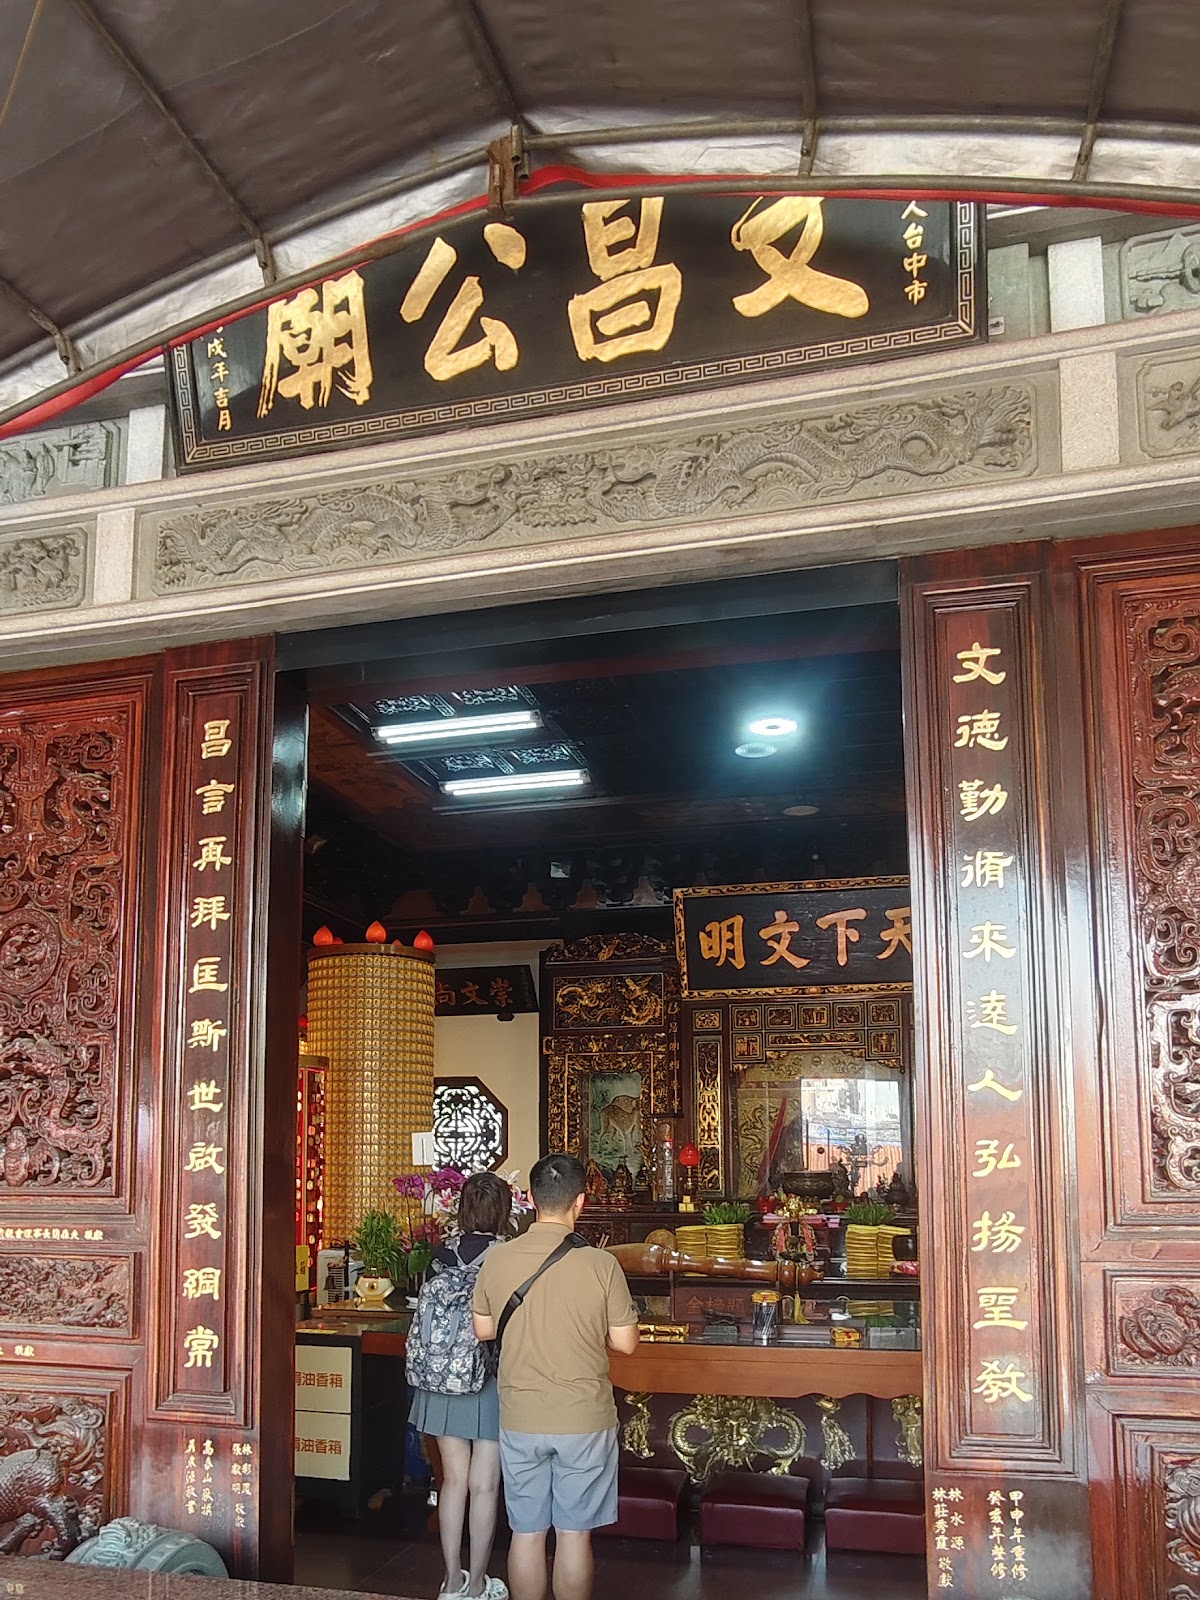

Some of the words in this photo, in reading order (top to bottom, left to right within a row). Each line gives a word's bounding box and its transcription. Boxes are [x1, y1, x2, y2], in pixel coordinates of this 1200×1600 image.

[257, 196, 869, 418] 文昌公廟
[699, 908, 911, 969] 天下文明
[1009, 1490, 1028, 1580] 甲申年重修
